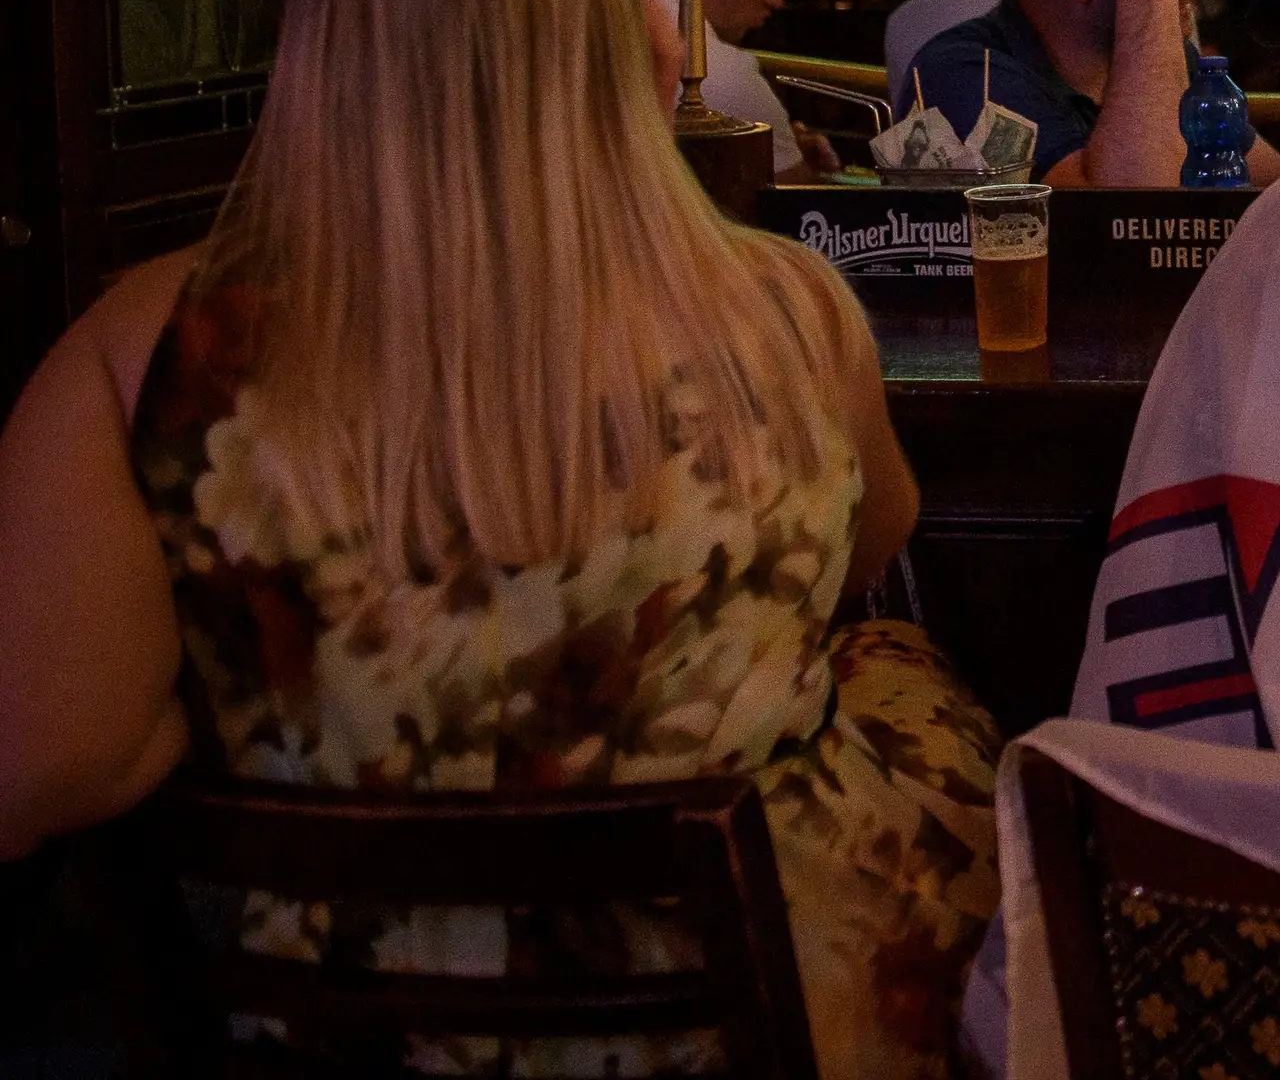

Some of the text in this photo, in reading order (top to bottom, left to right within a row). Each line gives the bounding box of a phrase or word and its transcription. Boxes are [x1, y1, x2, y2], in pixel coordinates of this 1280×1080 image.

[799, 208, 969, 261] Pilsner Urquel
[1111, 217, 1237, 240] DELIVERED
[1150, 246, 1220, 269] DIREC
[914, 264, 944, 277] TANK
[946, 264, 974, 277] BEER
